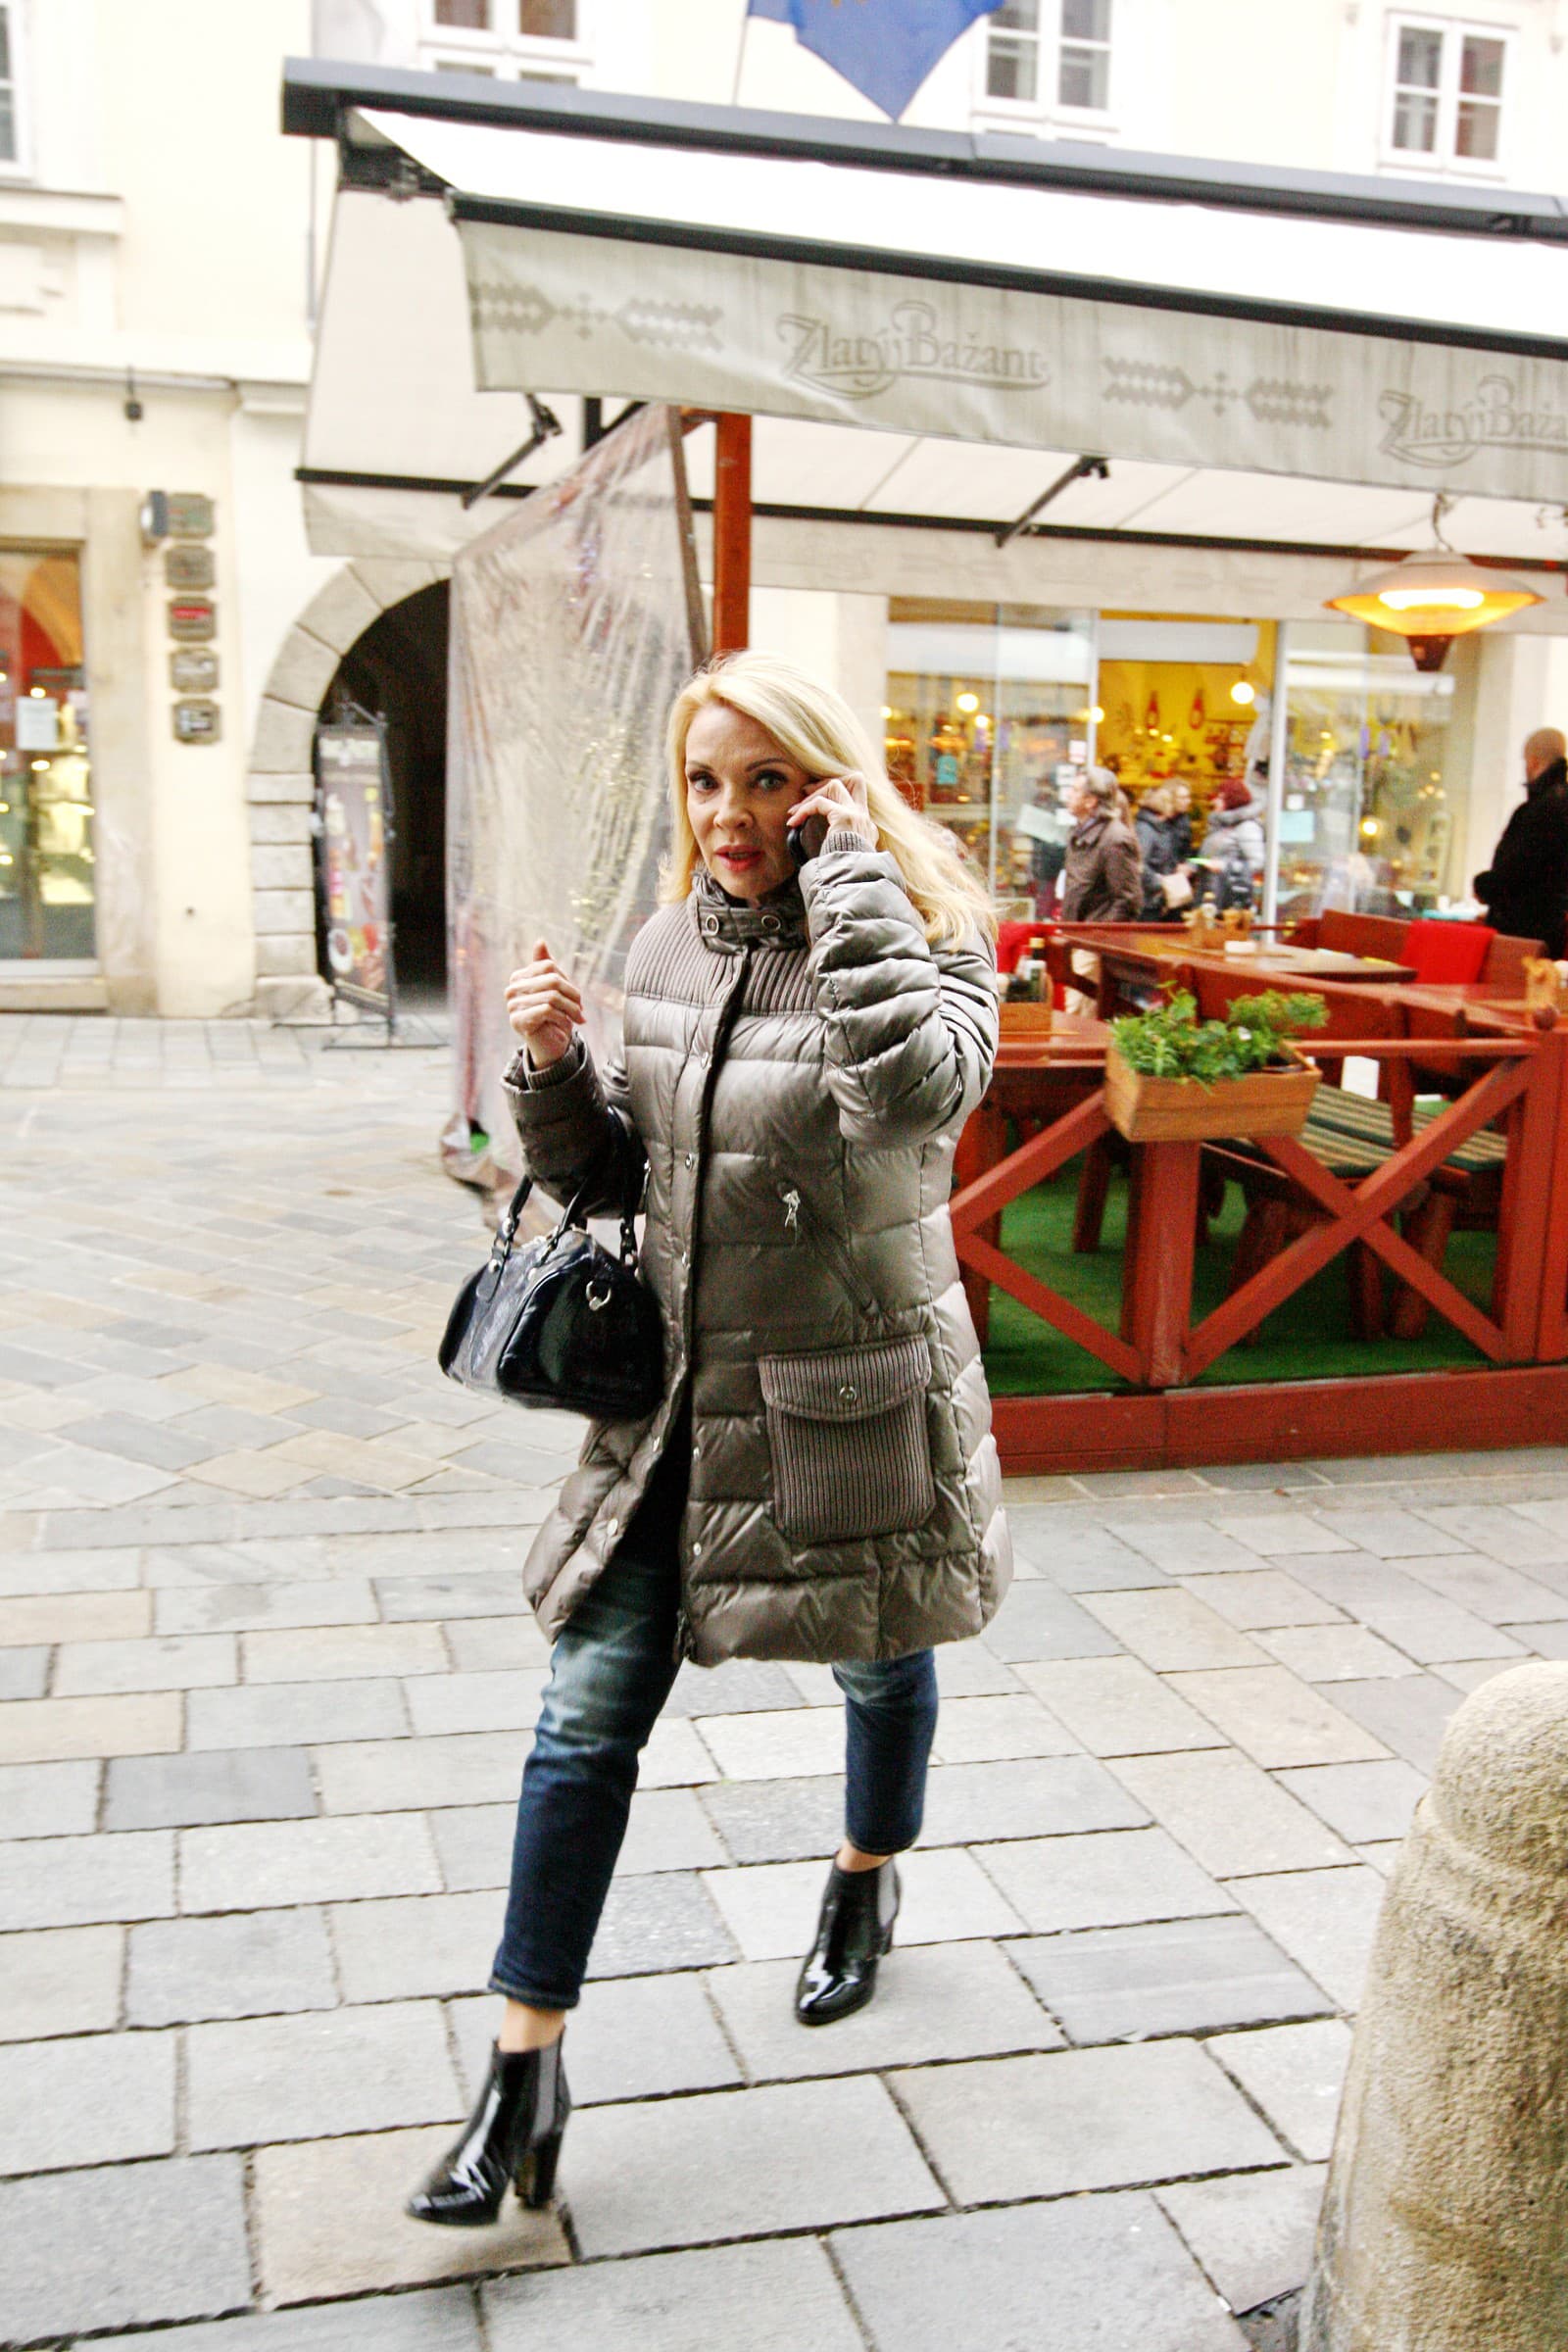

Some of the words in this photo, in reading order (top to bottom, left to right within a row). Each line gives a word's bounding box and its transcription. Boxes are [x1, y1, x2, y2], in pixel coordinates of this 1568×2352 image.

[776, 313, 902, 401] Zlatý
[891, 300, 1047, 381] Bažant
[1477, 374, 1568, 444] Baža
